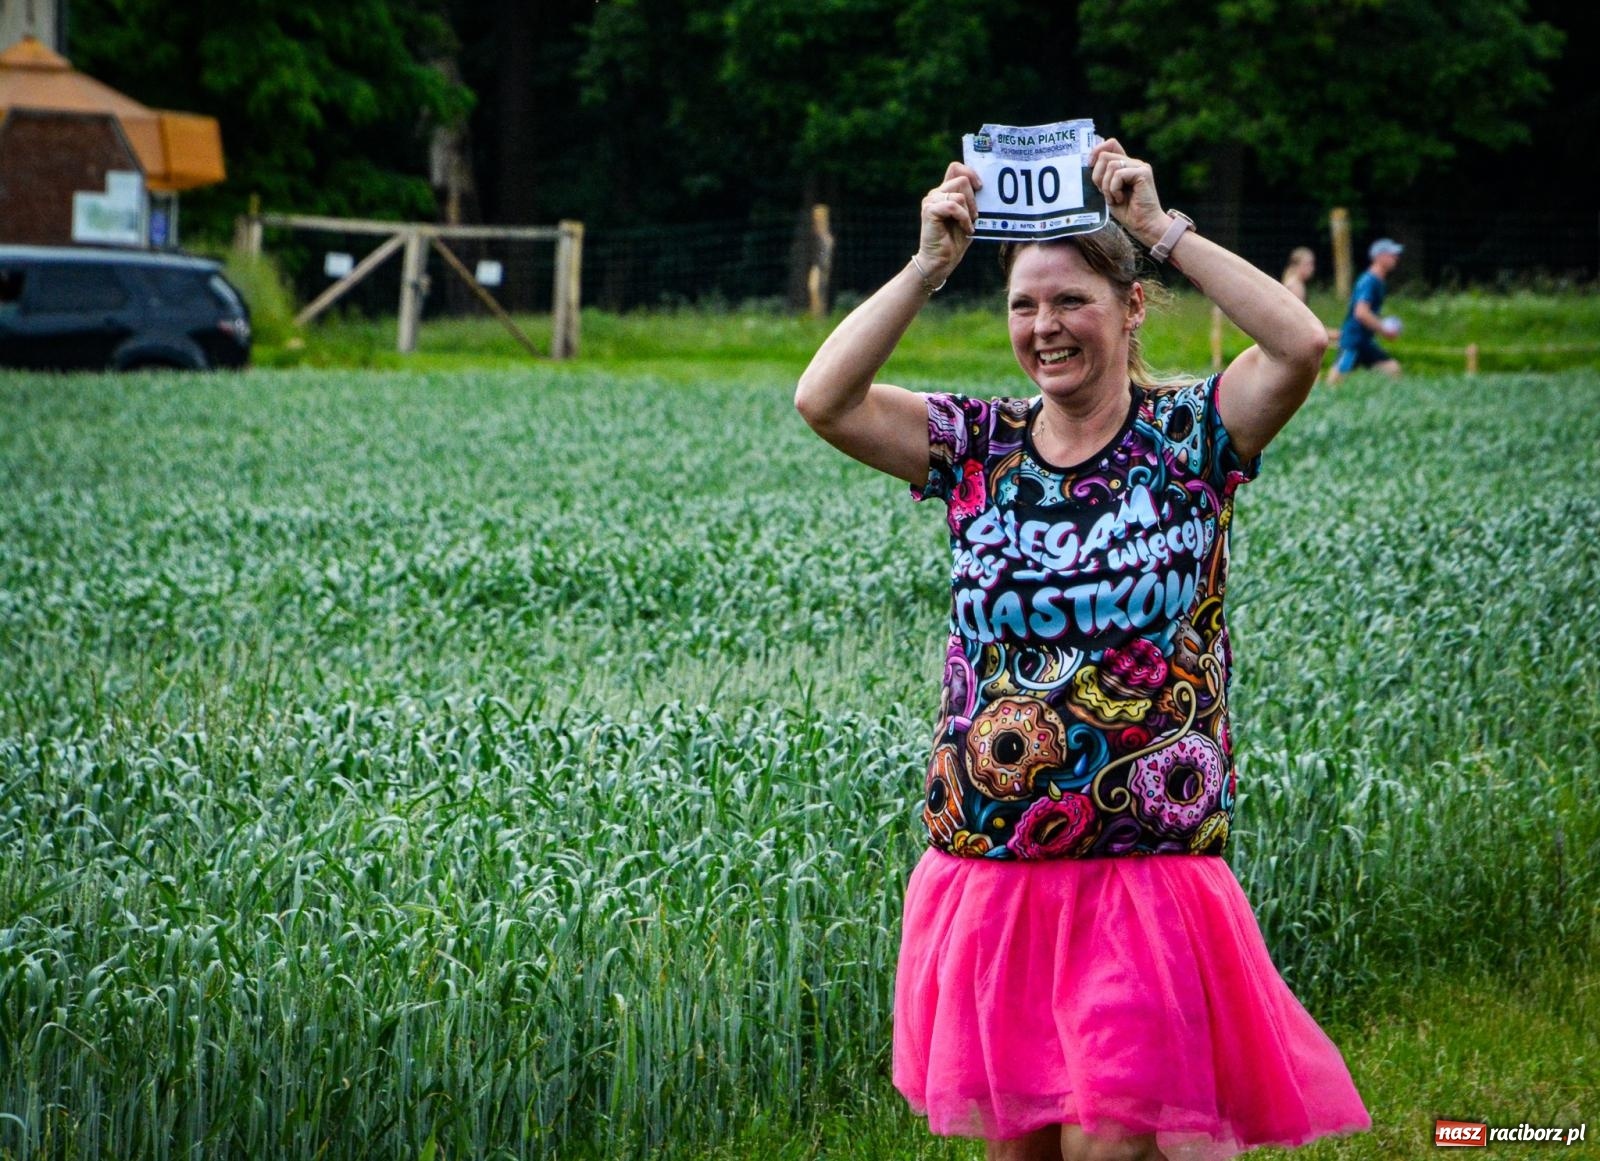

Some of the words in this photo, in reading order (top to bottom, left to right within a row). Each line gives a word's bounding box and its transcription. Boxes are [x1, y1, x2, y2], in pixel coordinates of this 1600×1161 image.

[997, 133, 1016, 145] BIEG
[1017, 135, 1036, 146] NA
[1038, 129, 1076, 145] PIĄTKĘ
[997, 165, 1061, 207] 010
